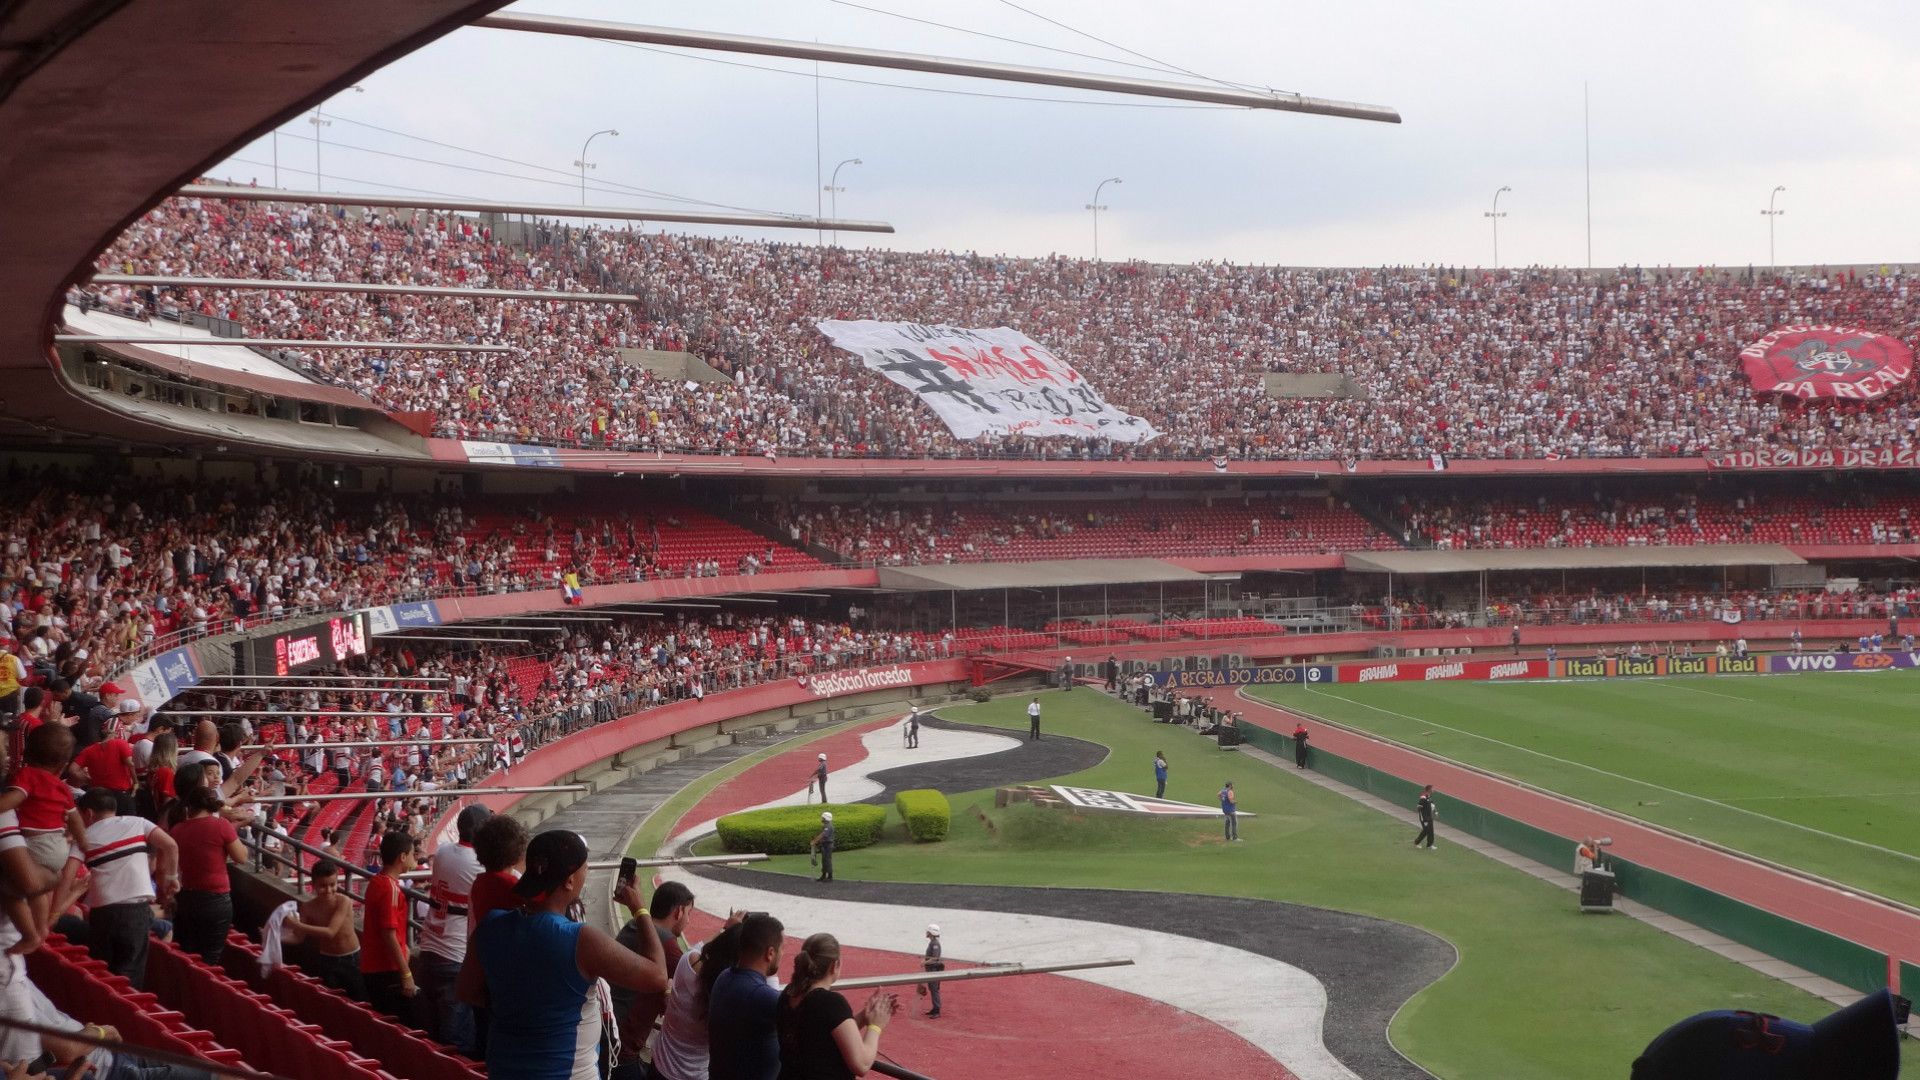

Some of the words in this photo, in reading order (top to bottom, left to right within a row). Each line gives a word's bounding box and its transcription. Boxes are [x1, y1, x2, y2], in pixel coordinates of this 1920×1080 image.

[1772, 381, 1818, 398] DA
[1831, 364, 1910, 399] REAL
[1490, 661, 1529, 679] BRAHMA
[1568, 658, 1604, 676] Itaú
[1618, 657, 1655, 675] Itaú
[1669, 657, 1705, 673] Itaú
[1719, 656, 1755, 673] Itaú
[1787, 655, 1837, 670] VIVO
[1853, 654, 1875, 668] 4G
[1167, 673, 1177, 687] A
[1181, 671, 1226, 686] REGRA
[1230, 669, 1251, 683] DO
[1254, 668, 1296, 683] JOGO
[1359, 664, 1398, 682] BRAHMA
[1425, 662, 1464, 680] BRAHMA
